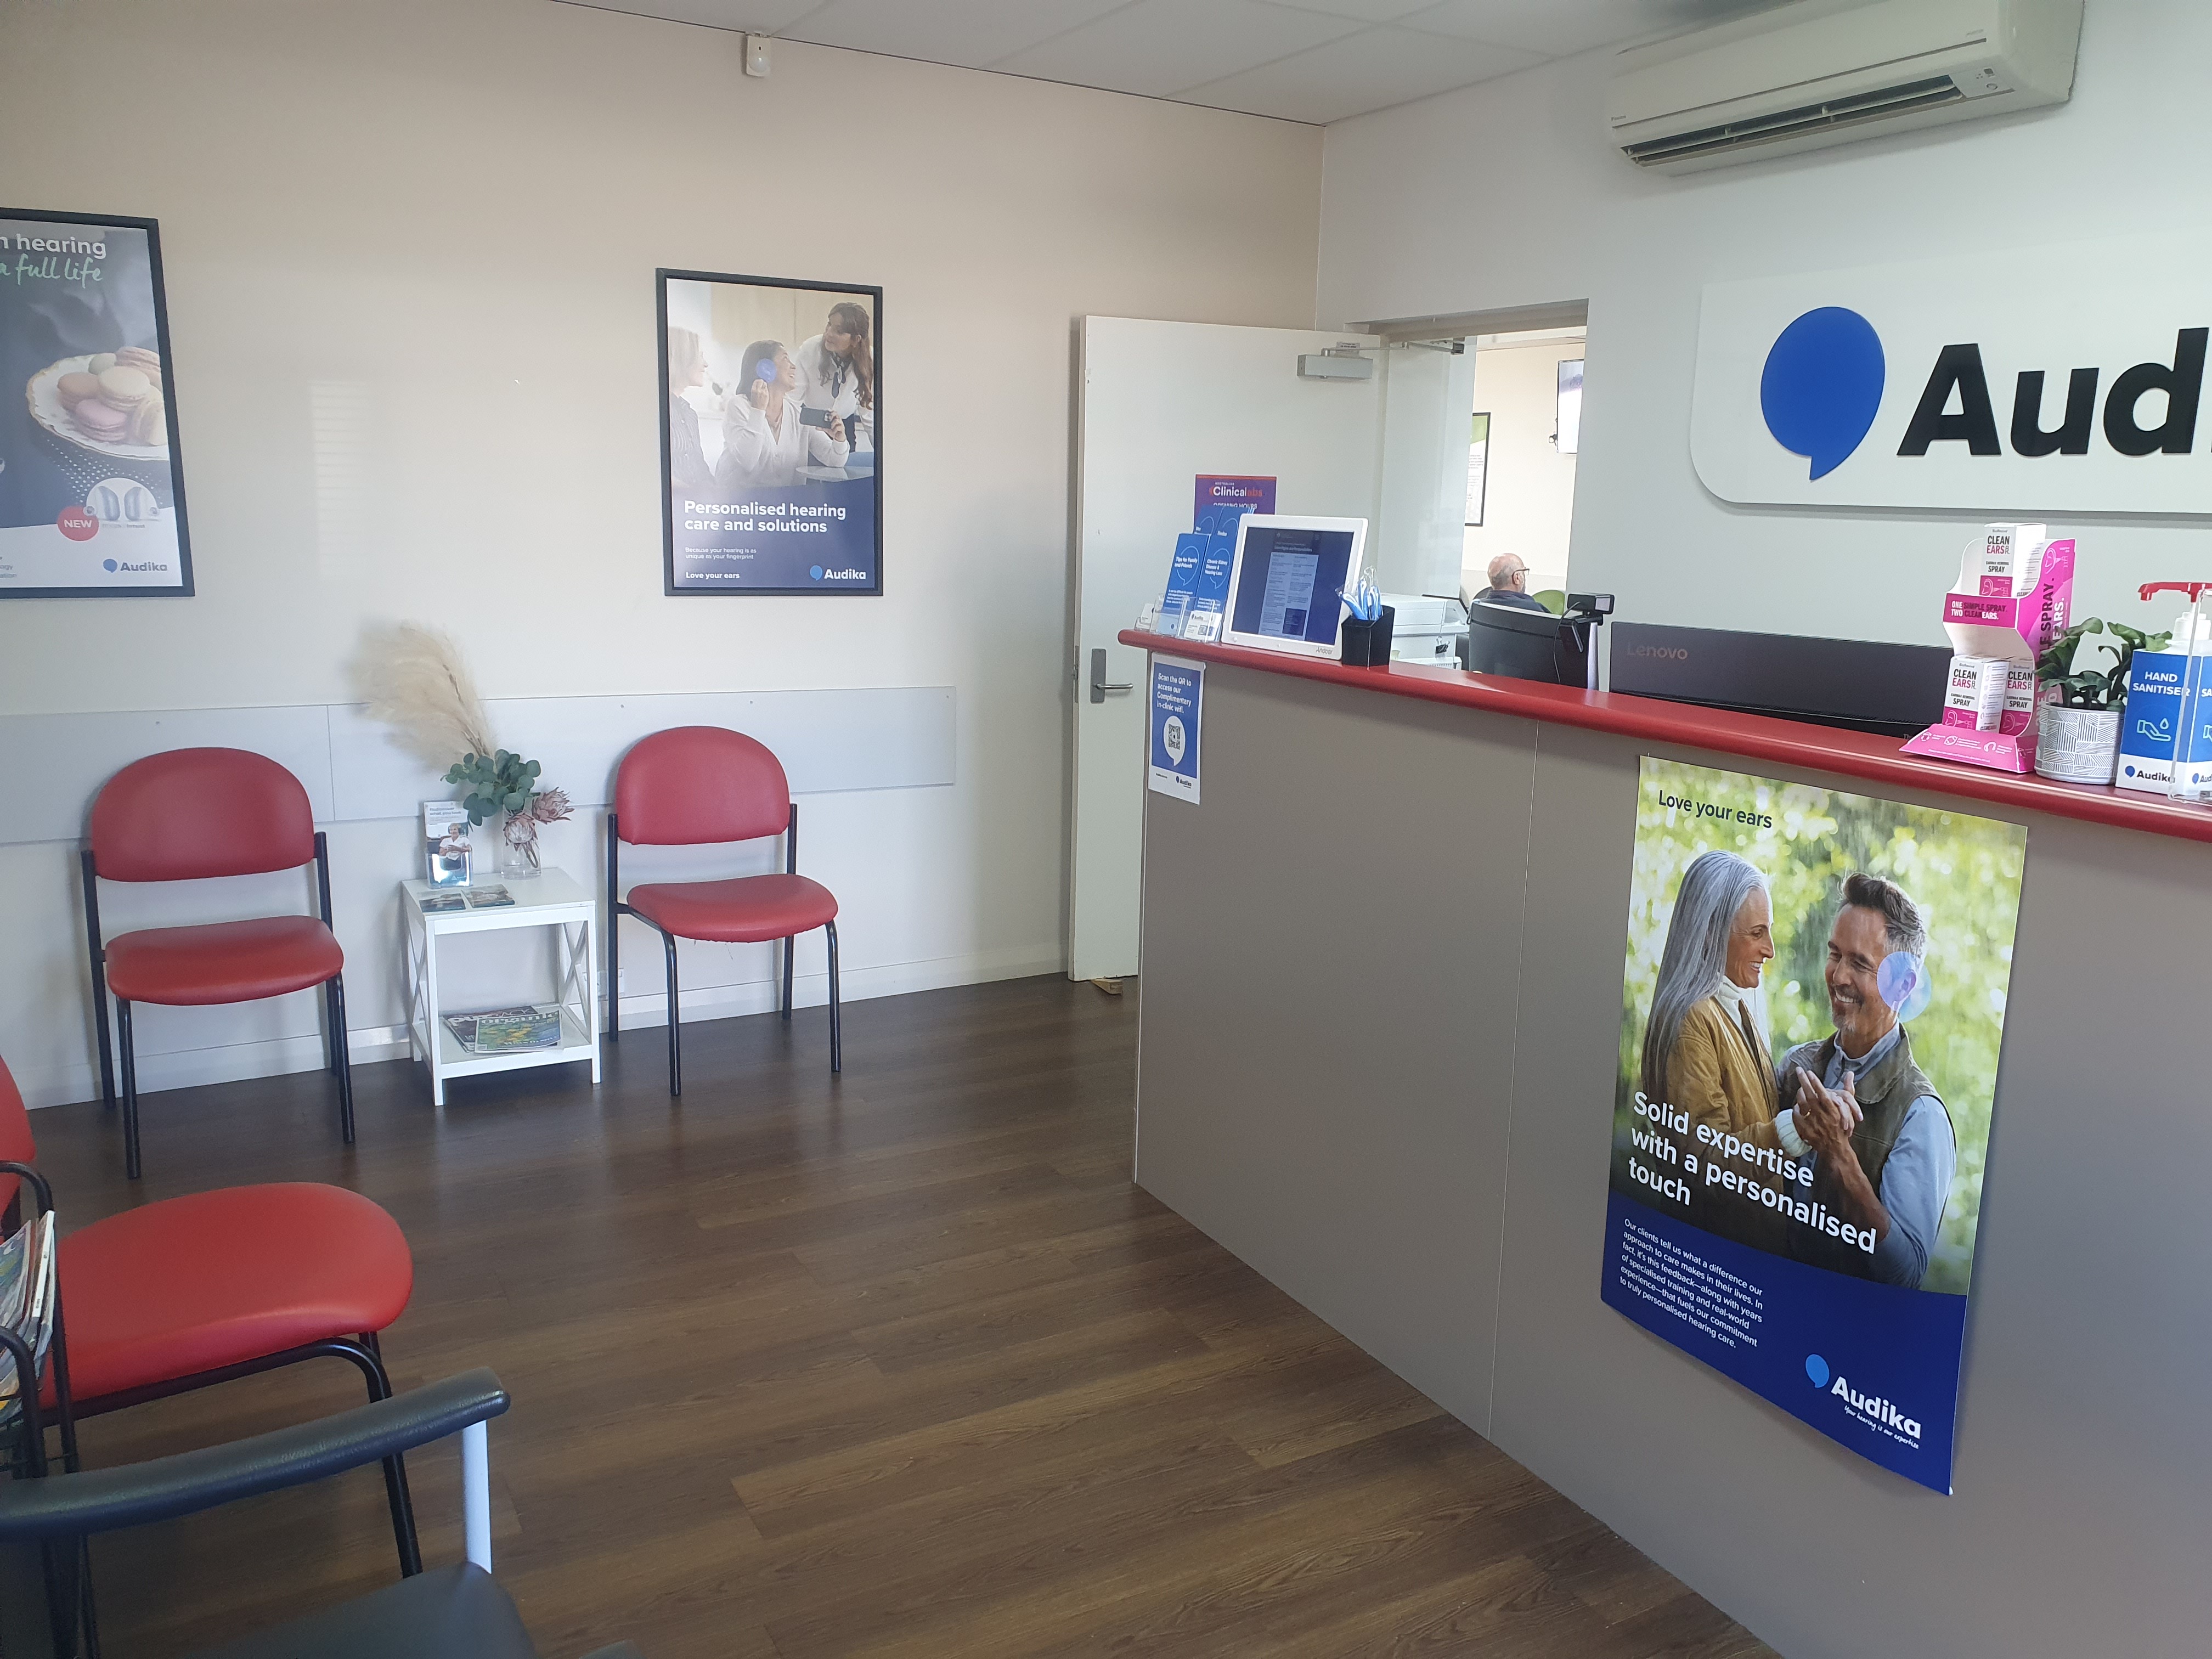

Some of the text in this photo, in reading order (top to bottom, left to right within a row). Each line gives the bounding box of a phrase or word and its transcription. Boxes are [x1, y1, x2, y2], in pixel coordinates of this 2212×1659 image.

[16, 233, 106, 259] hearing
[15, 253, 60, 285] full
[65, 257, 102, 289] life
[1897, 328, 2212, 456] Aud
[685, 500, 846, 520] Personalised hearing
[64, 520, 92, 528] NEW
[685, 519, 827, 533] care and solutions
[1988, 535, 2010, 545] CLEAN
[120, 561, 167, 571] Audika
[824, 568, 866, 579] Audika
[1627, 642, 1688, 659] Lenovo
[1158, 673, 1169, 681] Scan
[1954, 669, 1977, 680] CLEAN
[2008, 671, 2033, 681] CLEAN
[2145, 672, 2177, 682] HAND
[1158, 691, 1191, 707] Complimentary
[1953, 698, 1971, 707] SPRAY
[2133, 682, 2191, 697] SANITISER
[1658, 789, 1772, 828] Love your ears
[1633, 1091, 1814, 1187] Solid expertise
[1628, 1156, 1690, 1206] touch
[1630, 1127, 1877, 1255] with a personalised
[1624, 1218, 1636, 1231] Our
[1638, 1227, 1658, 1243] clients
[1661, 1238, 1671, 1250] tell
[1673, 1246, 1681, 1255] us
[1683, 1250, 1701, 1265] what
[1709, 1263, 1747, 1288] difference
[1749, 1284, 1762, 1296] our
[1623, 1241, 1635, 1256] fact,
[1647, 1256, 1659, 1268] this
[1724, 1296, 1739, 1311] with
[1741, 1306, 1762, 1323] years
[1624, 1231, 1762, 1310] approach to care makes in their lives. In
[1622, 1254, 1750, 1329] of specialised training and real-world
[1620, 1276, 1736, 1348] to truly personalised hearing care.
[1678, 1297, 1695, 1312] fuels
[1696, 1308, 1709, 1320] our
[1711, 1316, 1757, 1347] commitment
[1831, 1376, 1921, 1439] Audika
[1844, 1405, 1856, 1416] Your
[1857, 1412, 1876, 1431] hearing
[1894, 1434, 1918, 1449] expertise
